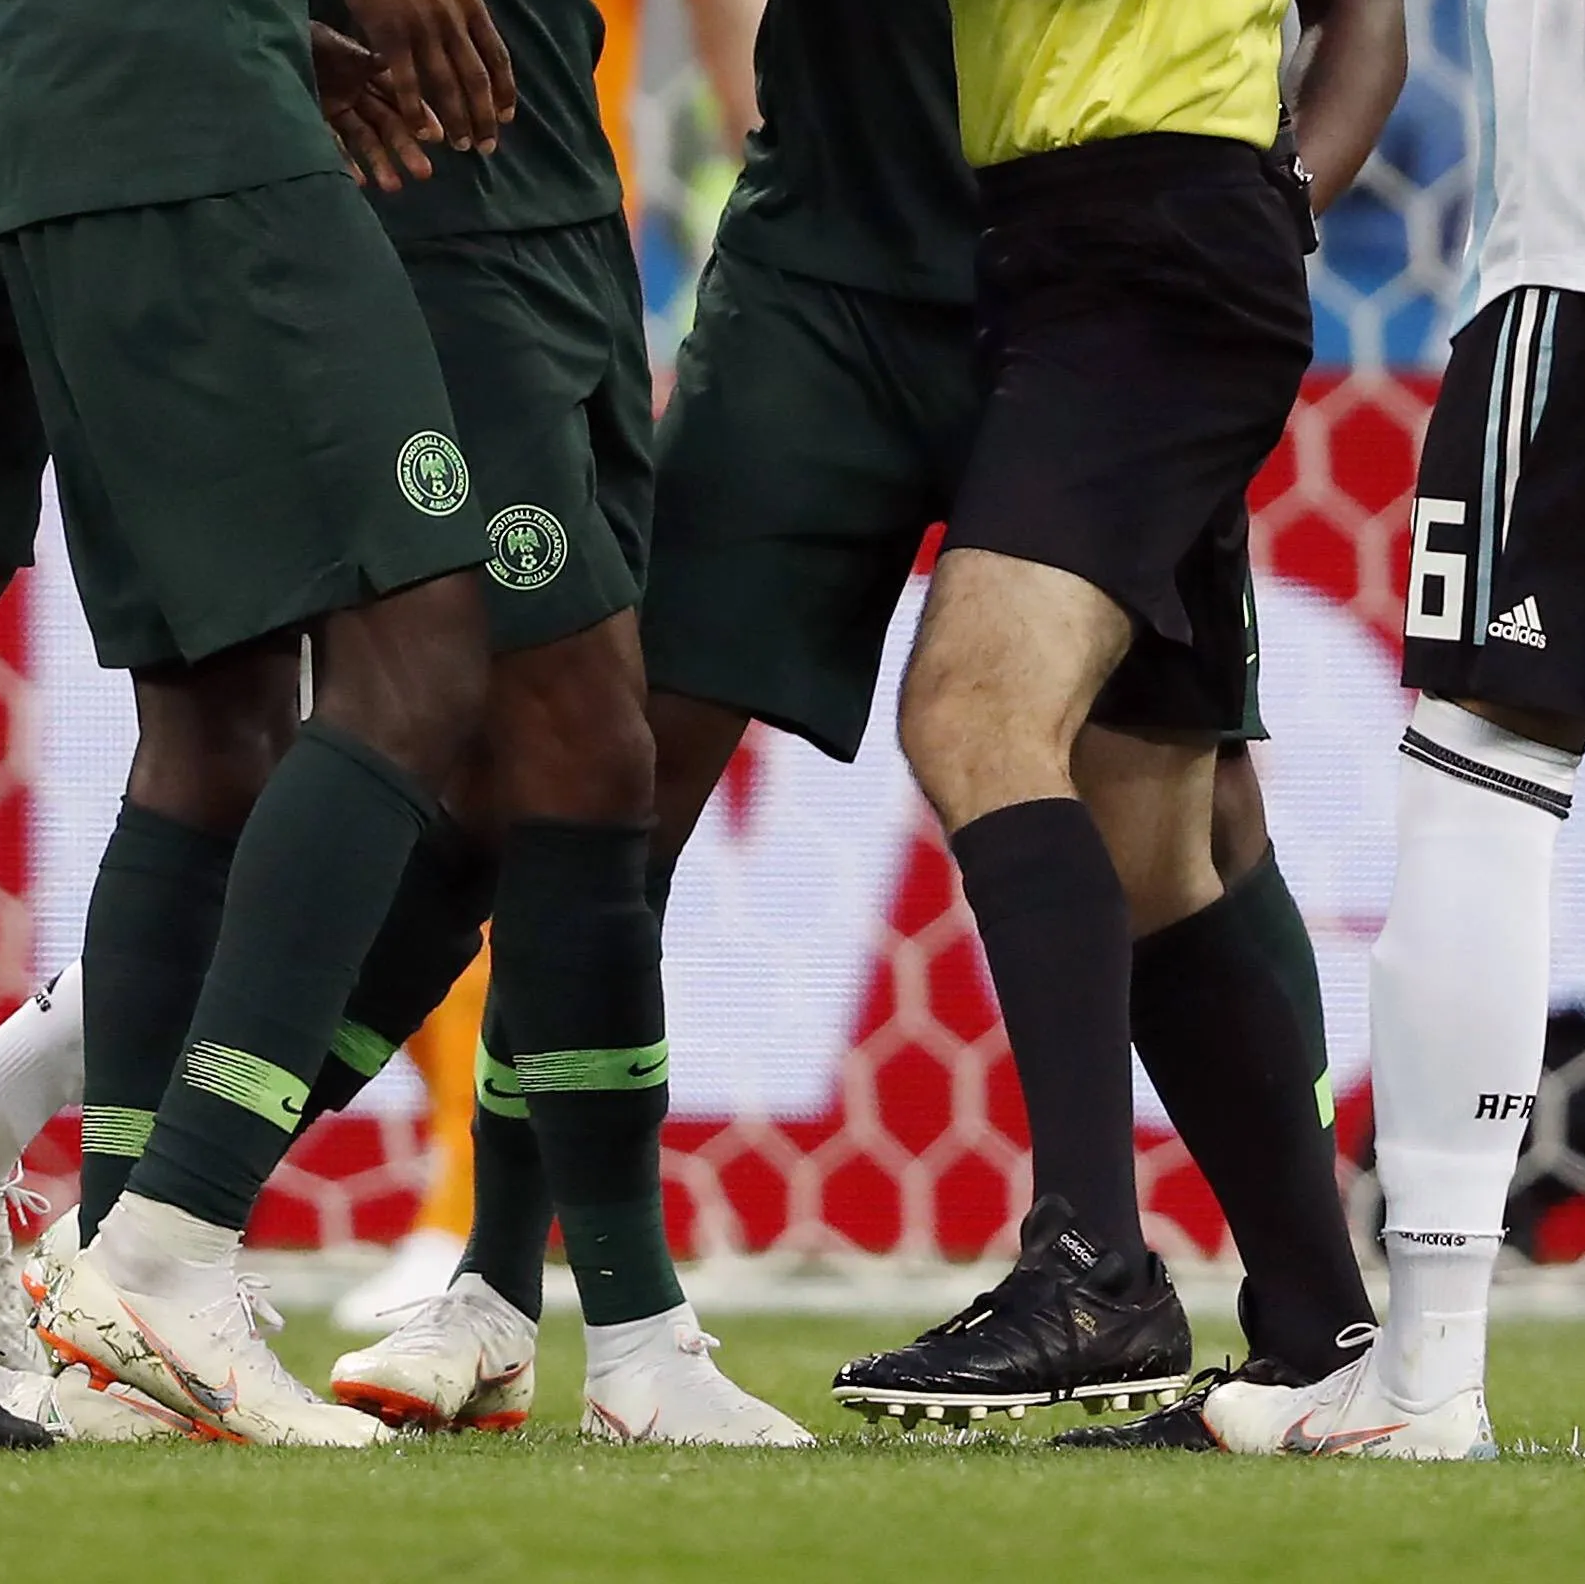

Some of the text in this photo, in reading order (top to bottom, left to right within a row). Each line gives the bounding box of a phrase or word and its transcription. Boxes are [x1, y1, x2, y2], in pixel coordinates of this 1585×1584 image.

[1406, 497, 1466, 641] 6
[1488, 621, 1547, 649] adidas
[1475, 1094, 1536, 1120] AFA
